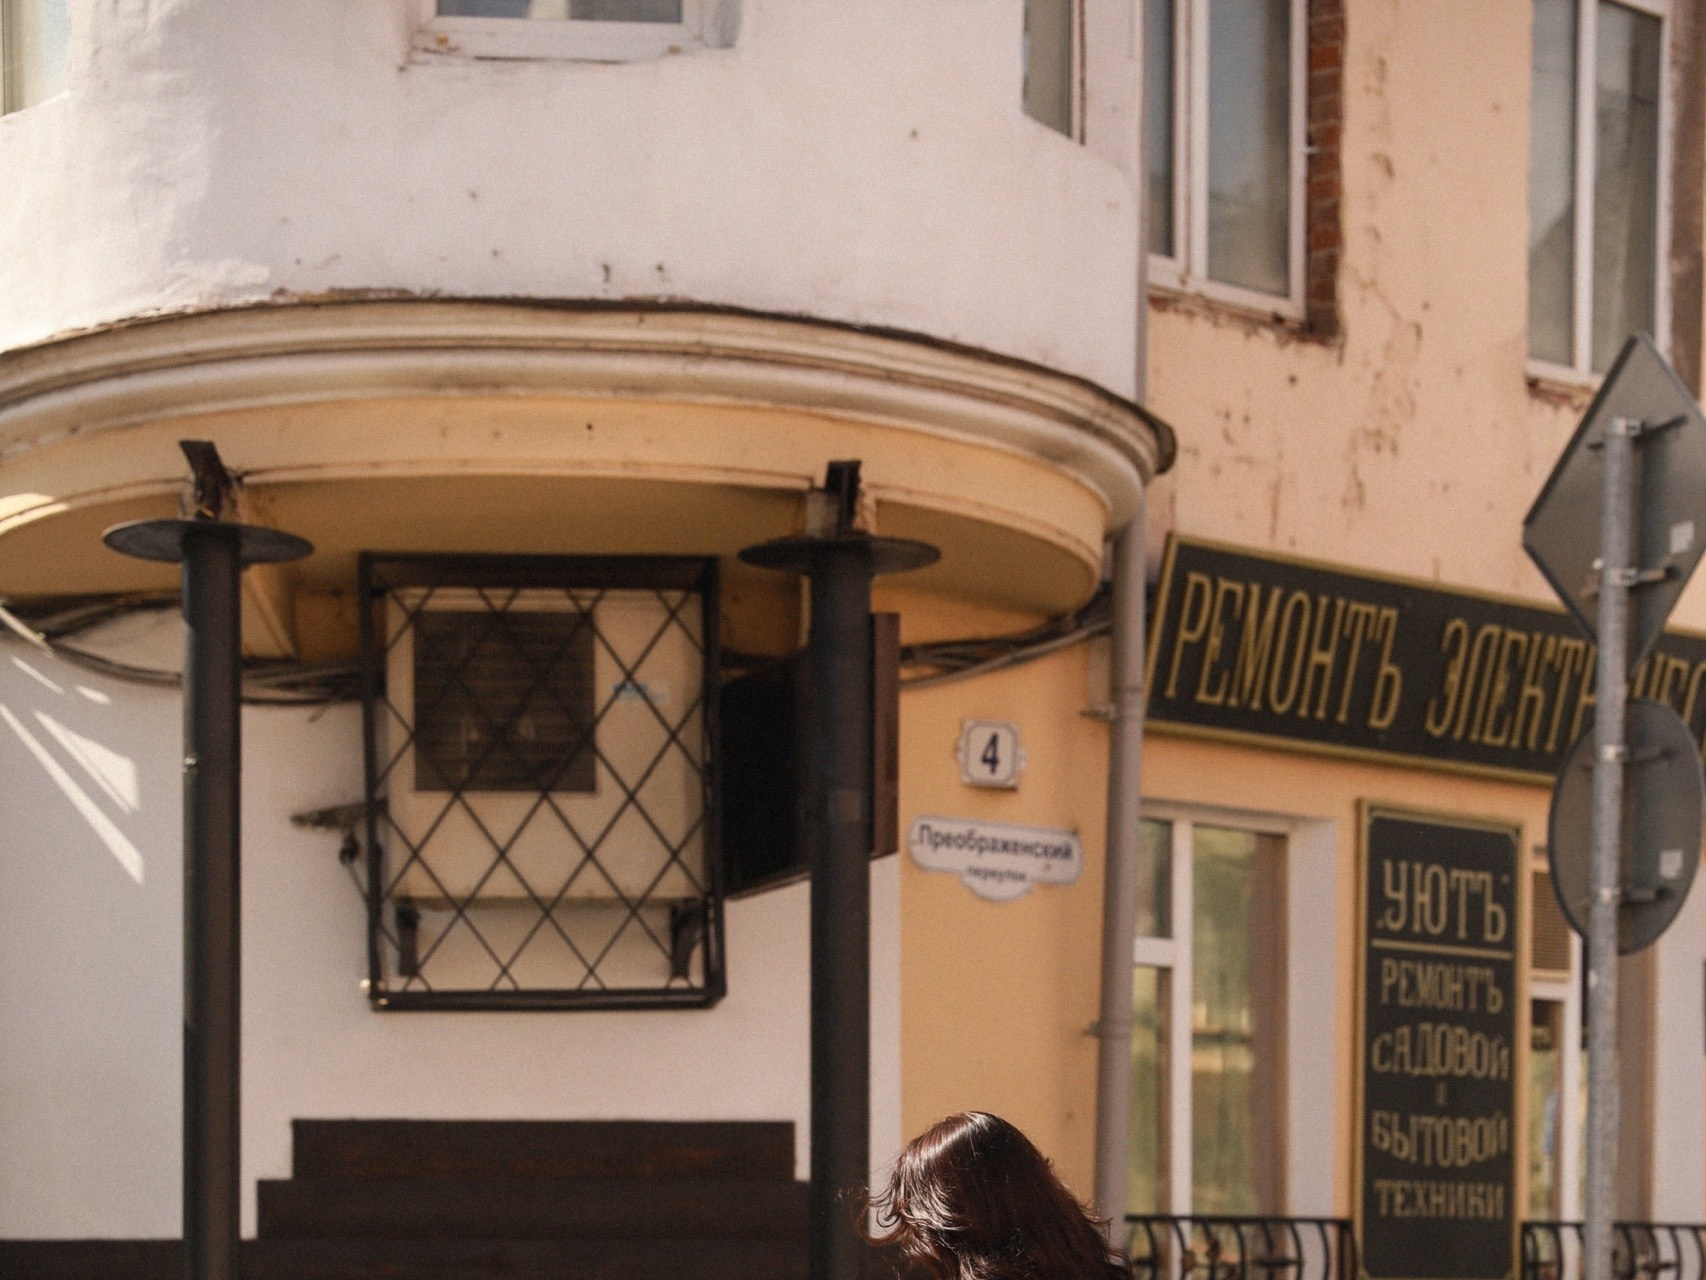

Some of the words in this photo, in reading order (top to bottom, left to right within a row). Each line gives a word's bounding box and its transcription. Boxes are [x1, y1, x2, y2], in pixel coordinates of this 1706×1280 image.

[1164, 569, 1403, 731] РЕМОНТЪ
[981, 731, 999, 774] 4
[1380, 956, 1504, 1014] РЕМОНТЪ
[1371, 1021, 1510, 1081] САДОВОЙ
[1371, 1109, 1510, 1168] БЫТОВОЙ
[1375, 1178, 1506, 1221] ТЕХНИКИ
